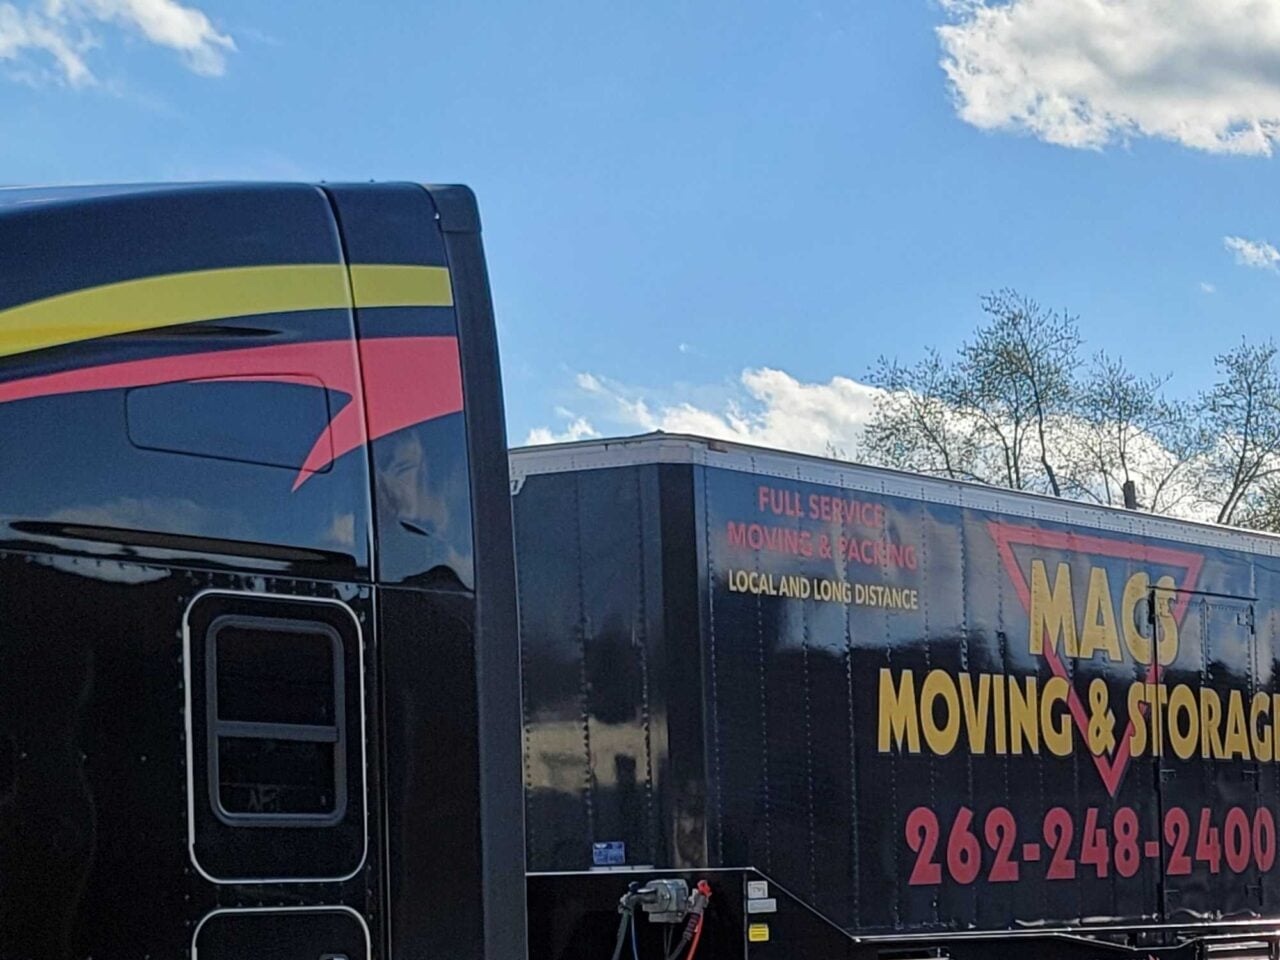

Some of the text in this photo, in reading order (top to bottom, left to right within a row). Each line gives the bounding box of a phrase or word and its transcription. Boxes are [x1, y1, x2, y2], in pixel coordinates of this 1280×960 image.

[758, 486, 883, 528] FULL SERVICE
[727, 521, 917, 571] MOVING & PACKING
[728, 569, 919, 610] LOCAL AND LONG DISTANCE
[1028, 558, 1180, 667] MACS
[877, 667, 1074, 757] MOVING
[1087, 679, 1117, 756] &
[904, 806, 1277, 887] 262-248-2400
